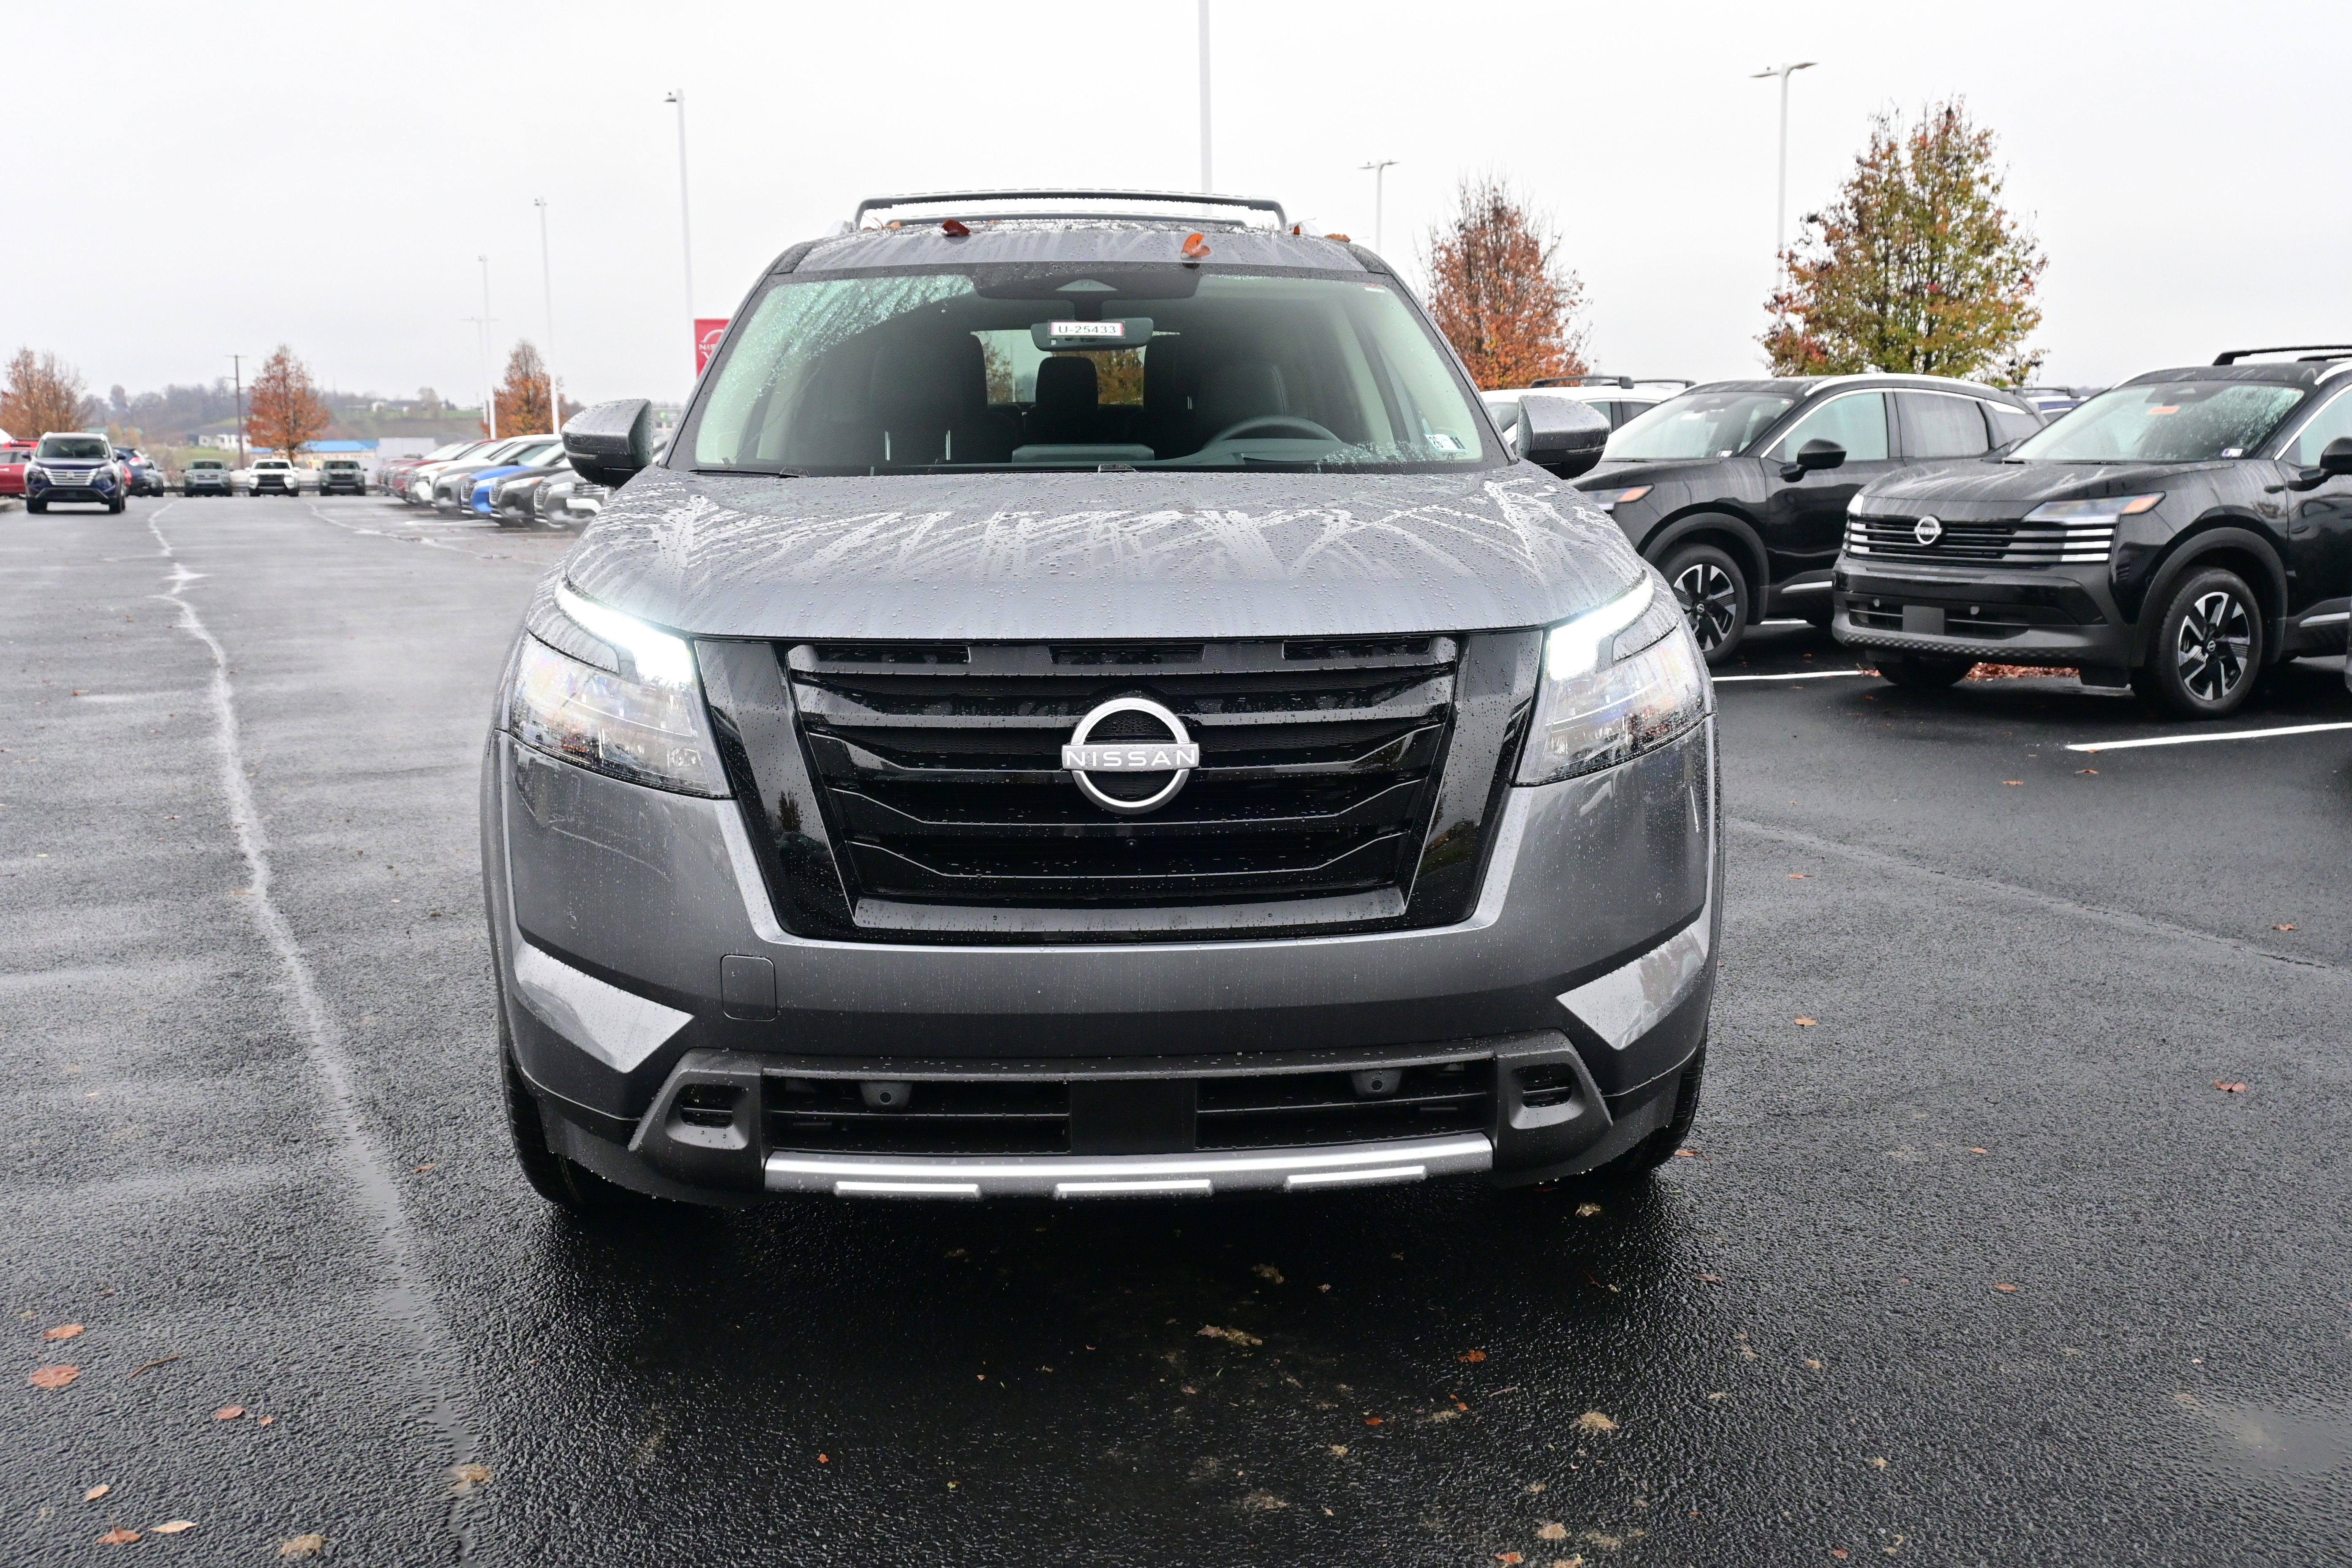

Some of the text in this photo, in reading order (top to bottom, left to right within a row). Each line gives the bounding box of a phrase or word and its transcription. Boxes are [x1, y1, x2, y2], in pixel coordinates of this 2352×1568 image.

[1429, 436, 1465, 449] 26 11
[1066, 749, 1195, 766] NISSAN
